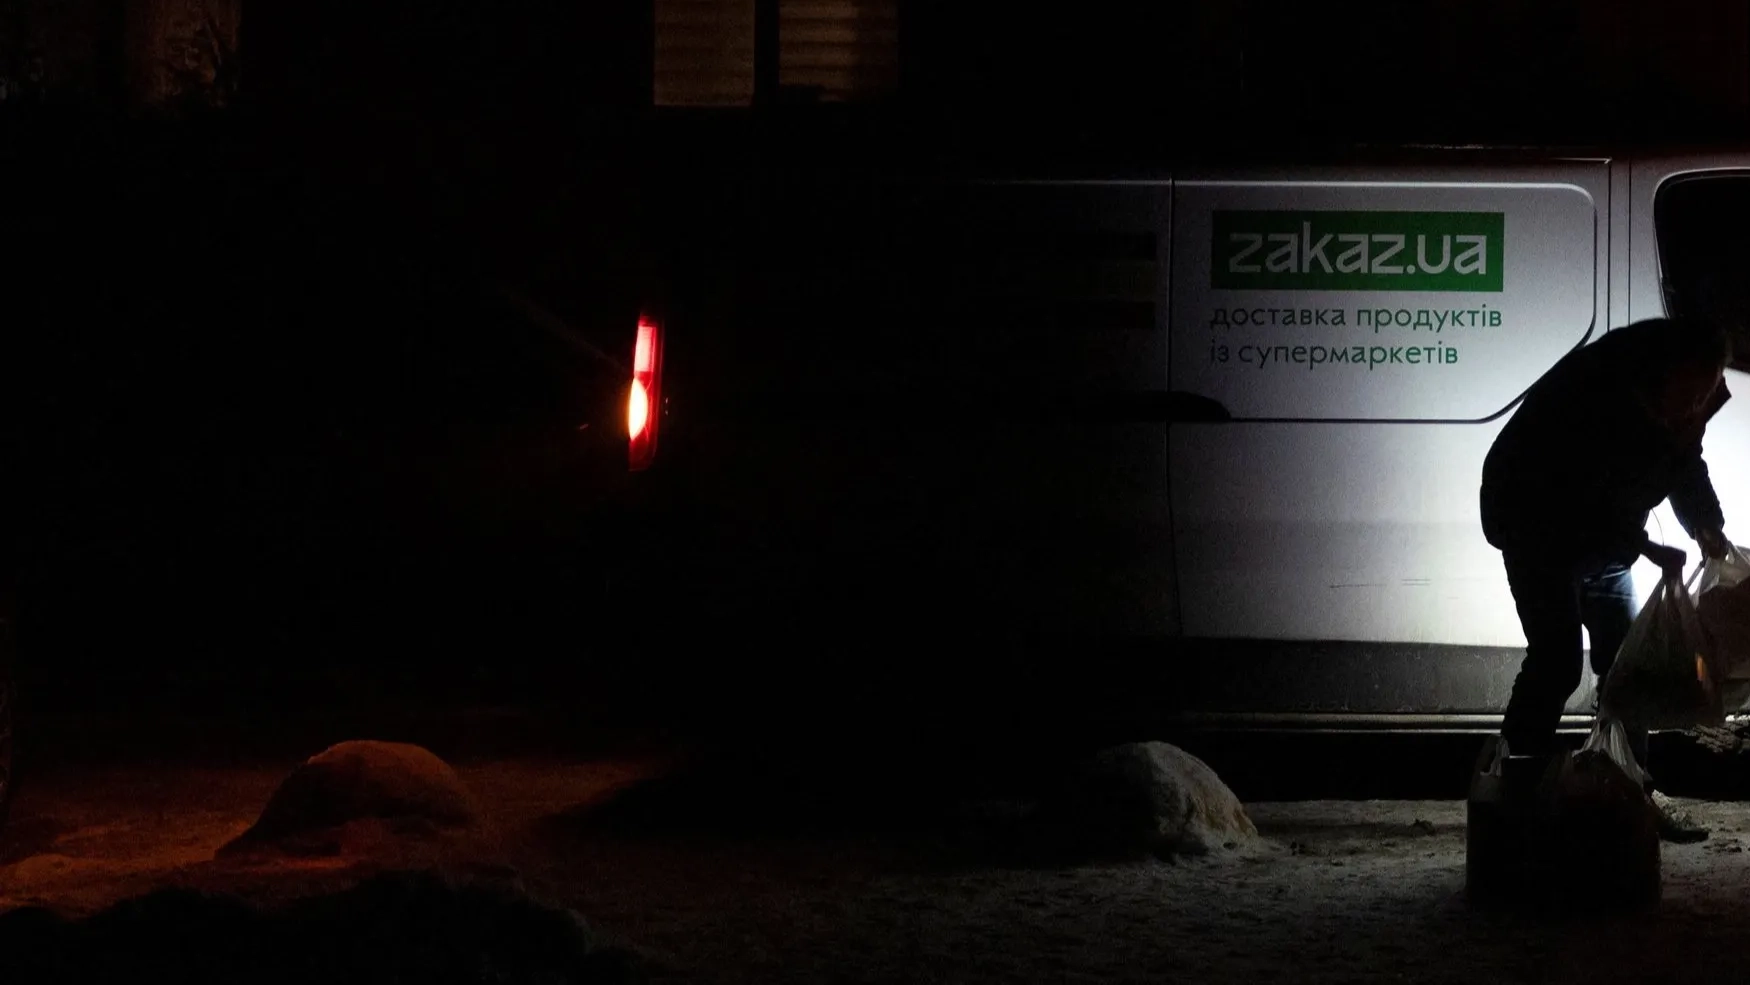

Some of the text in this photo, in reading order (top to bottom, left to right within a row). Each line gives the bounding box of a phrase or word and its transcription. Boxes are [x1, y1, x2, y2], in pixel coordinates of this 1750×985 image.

[1228, 220, 1487, 276] zakaz.ua
[1209, 303, 1502, 333] доставка продуктів
[1209, 339, 1458, 371] із супермаркетів
